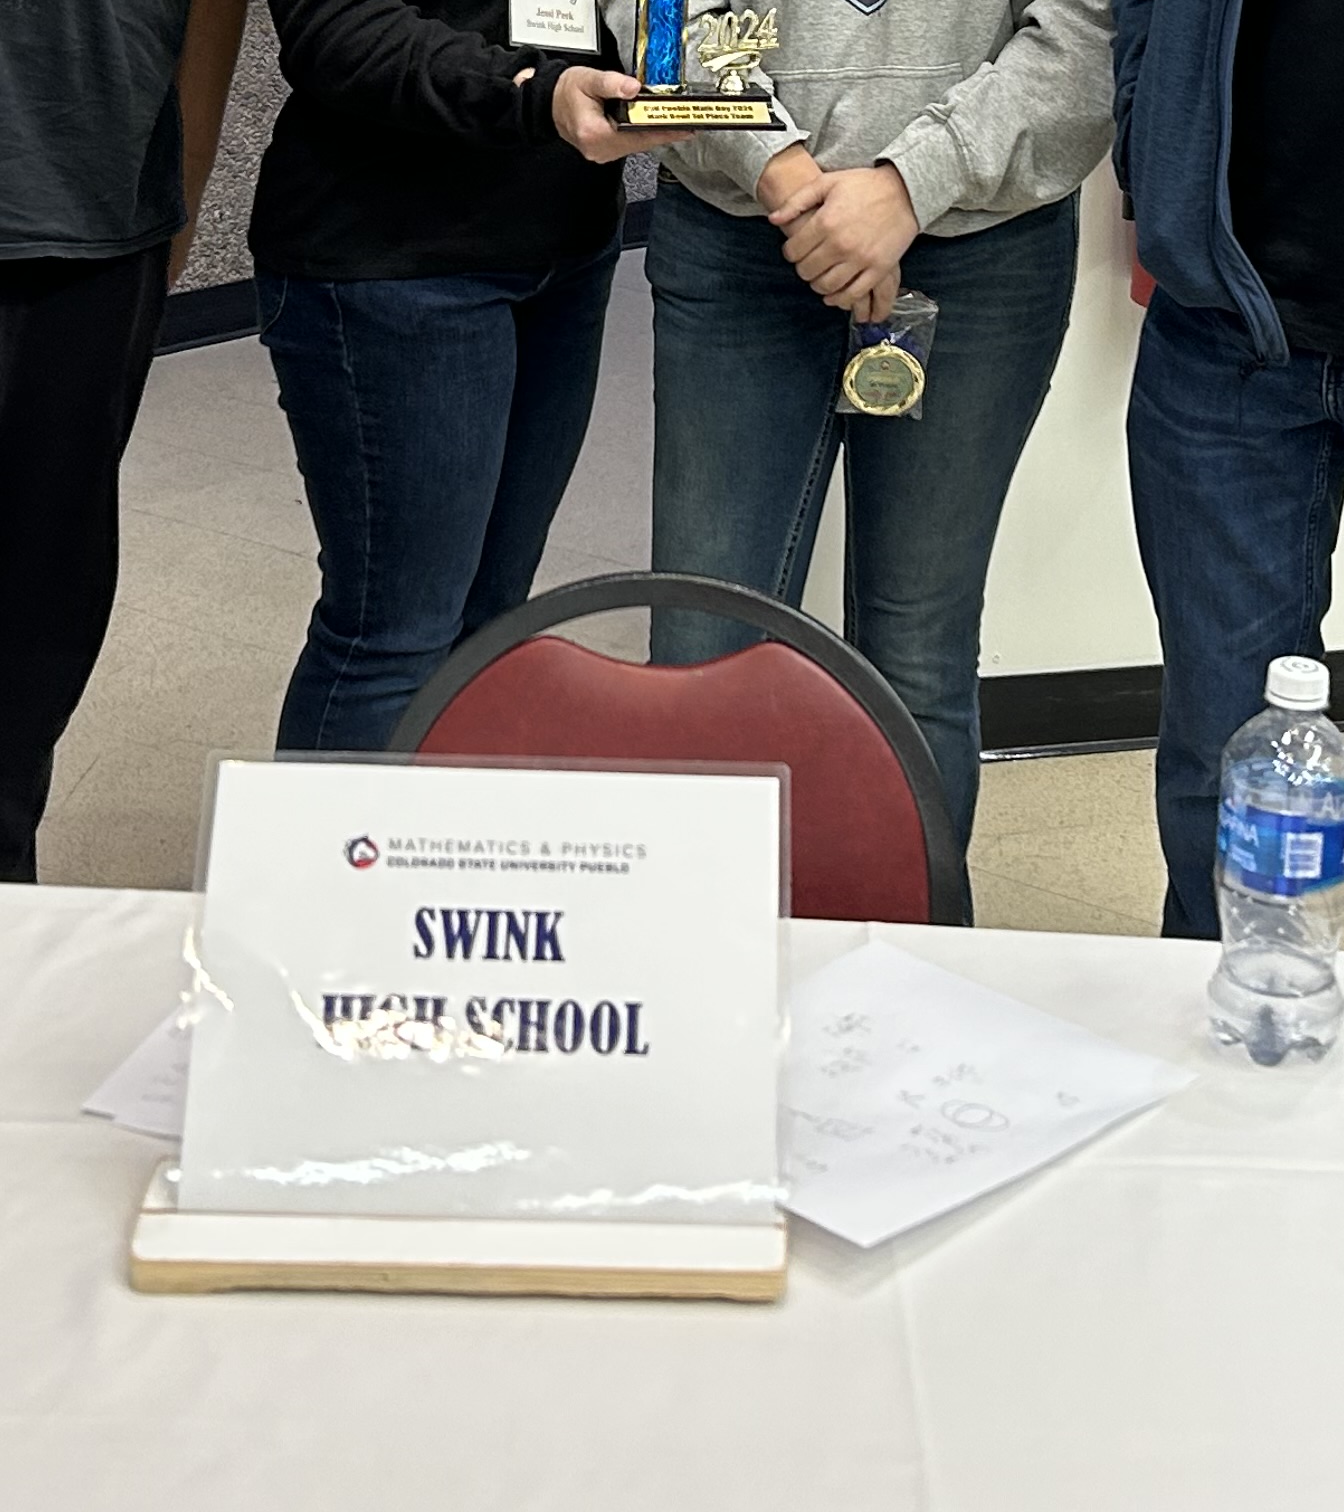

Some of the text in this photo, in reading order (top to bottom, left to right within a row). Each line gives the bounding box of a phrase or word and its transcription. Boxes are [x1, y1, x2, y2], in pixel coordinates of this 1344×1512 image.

[697, 7, 779, 51] 2024
[386, 837, 648, 860] MATHEMATICS & PHYSICS
[386, 855, 630, 875] COLORADO STATE UNIVERSITY PUEBLO
[413, 906, 566, 963] SWINK
[464, 995, 650, 1056] SCHOOL
